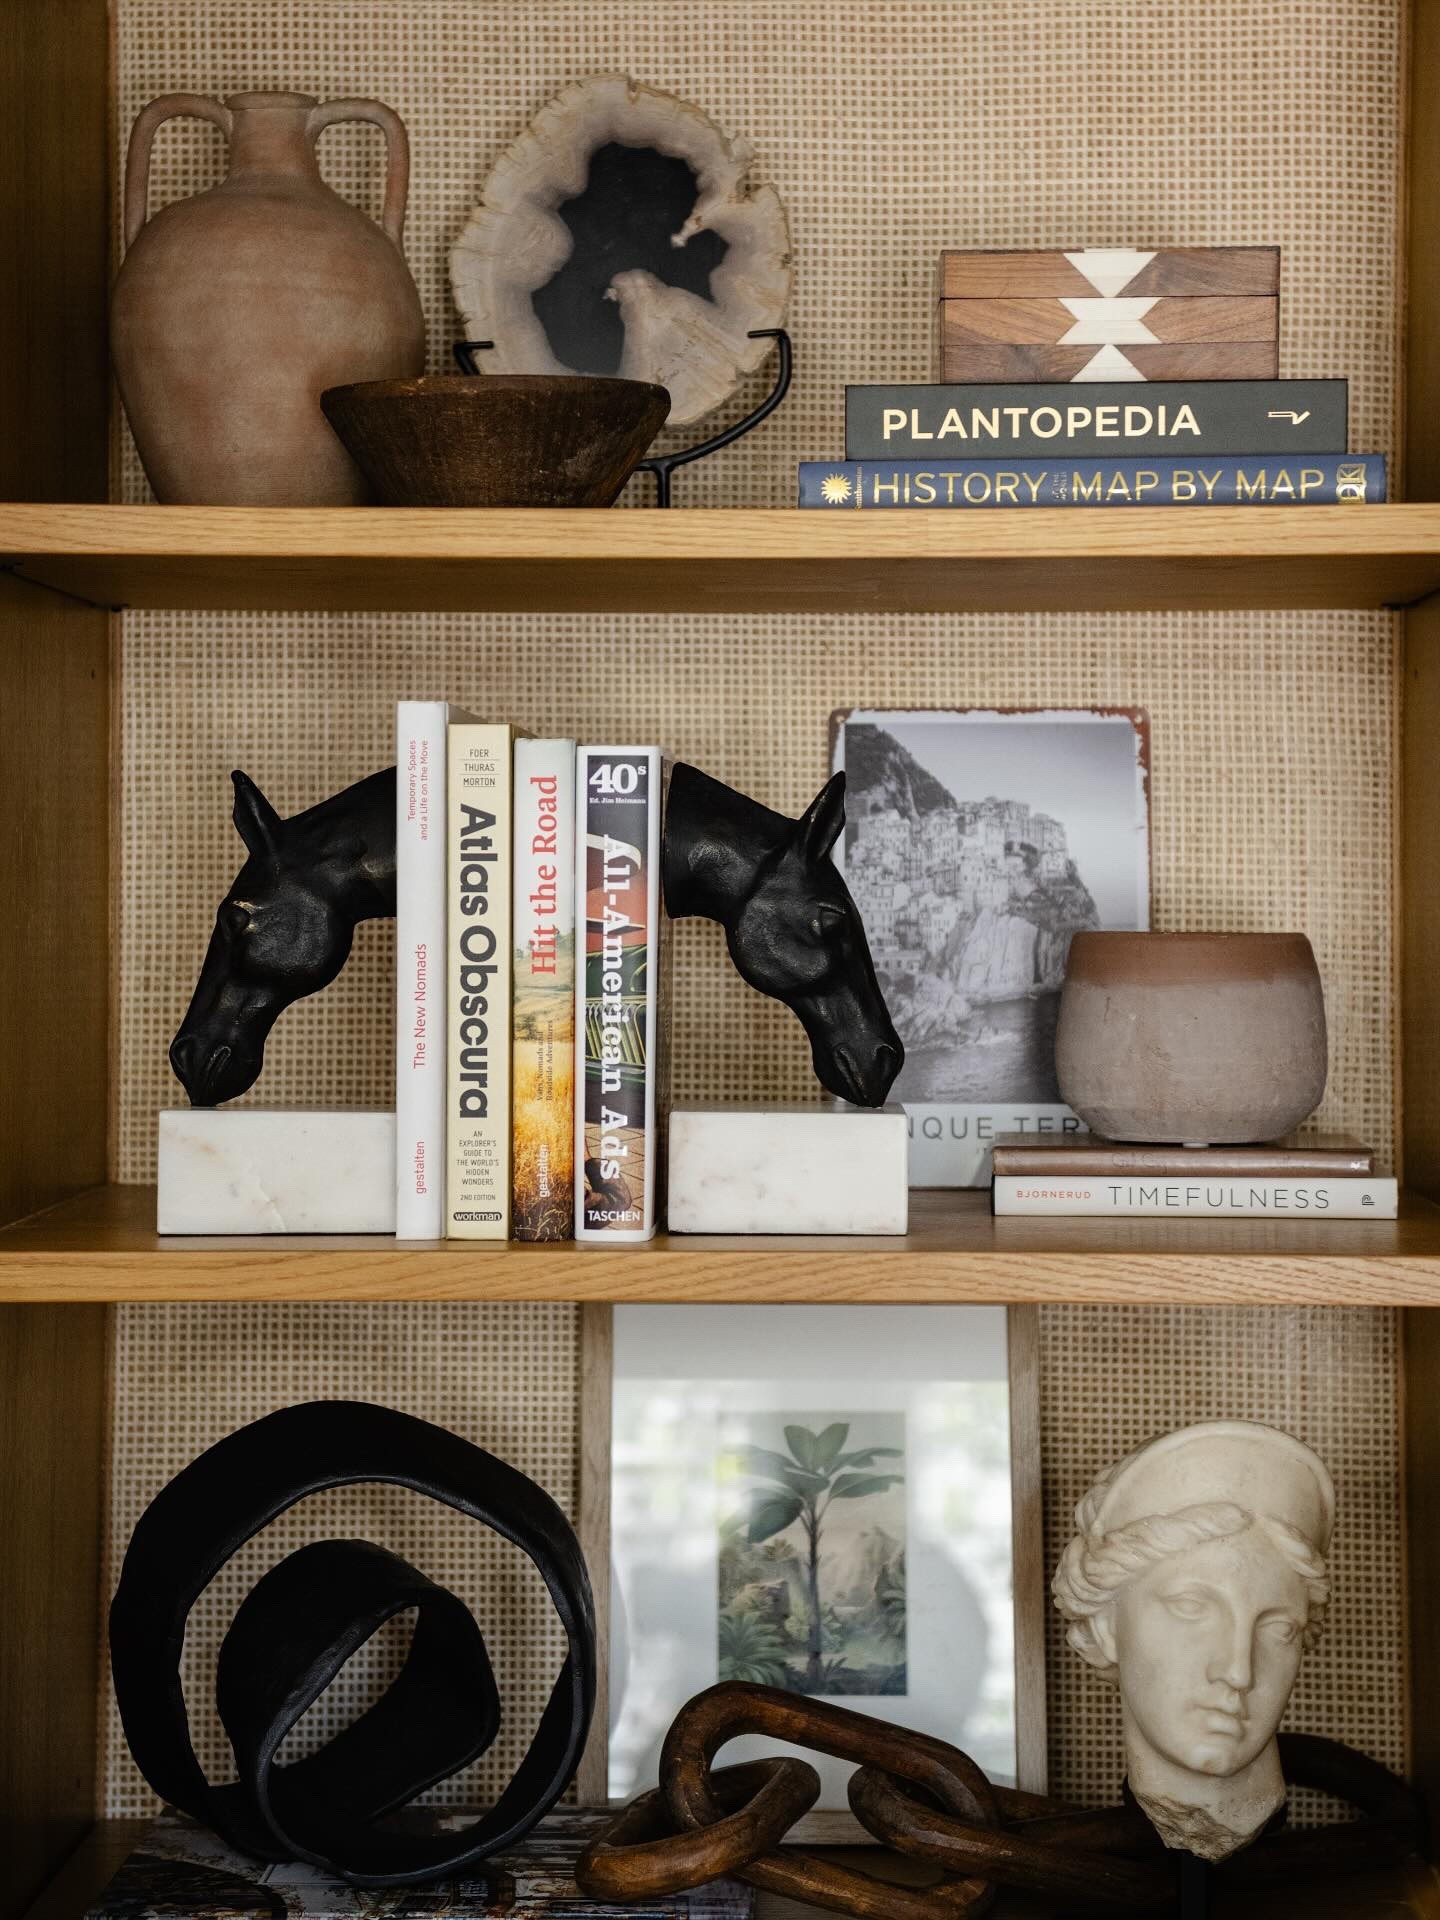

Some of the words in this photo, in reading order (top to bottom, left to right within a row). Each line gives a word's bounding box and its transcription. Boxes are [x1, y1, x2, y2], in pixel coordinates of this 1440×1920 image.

[882, 404, 1202, 440] PLANTOPEDIA
[873, 471, 1048, 504] HISTORY
[1072, 470, 1160, 502] MAP
[1171, 471, 1227, 500] BY
[1235, 469, 1326, 500] MAP
[1336, 463, 1367, 503] DK
[407, 740, 416, 770] Spaces
[420, 740, 428, 765] Move
[469, 748, 489, 759] FOER
[420, 767, 428, 781] the
[463, 777, 496, 787] MORTON
[464, 763, 495, 773] THURAS
[589, 763, 647, 794] 40s
[407, 769, 416, 821] Temporary
[422, 783, 428, 795] on
[420, 797, 428, 814] Life
[529, 775, 557, 855] Road
[420, 823, 428, 841] and
[460, 803, 498, 916] Atlas
[529, 864, 557, 916] the
[528, 923, 559, 975] Hit
[601, 834, 633, 1094] All-American
[413, 943, 427, 1001] Nomads
[413, 1006, 426, 1034] New
[459, 925, 498, 1118] Obscura
[413, 1037, 426, 1069] The
[545, 1020, 553, 1064] Adventures
[545, 1067, 553, 1101] Roadside
[600, 1105, 628, 1180] Ads
[908, 1116, 993, 1141] QUE
[414, 1141, 425, 1194] gestalten
[457, 1159, 469, 1167] THE
[470, 1159, 499, 1167] WORLD'S
[463, 1149, 482, 1157] GUIDE
[484, 1149, 493, 1157] TO
[461, 1178, 494, 1186] WONDERS
[465, 1168, 490, 1176] HIDDEN
[539, 1144, 549, 1198] gestalten
[1016, 1190, 1092, 1199] BJORNERUD
[1108, 1186, 1330, 1209] TIMEFULNESS
[455, 1213, 501, 1221] workman
[588, 1211, 640, 1222] TASCHEN
